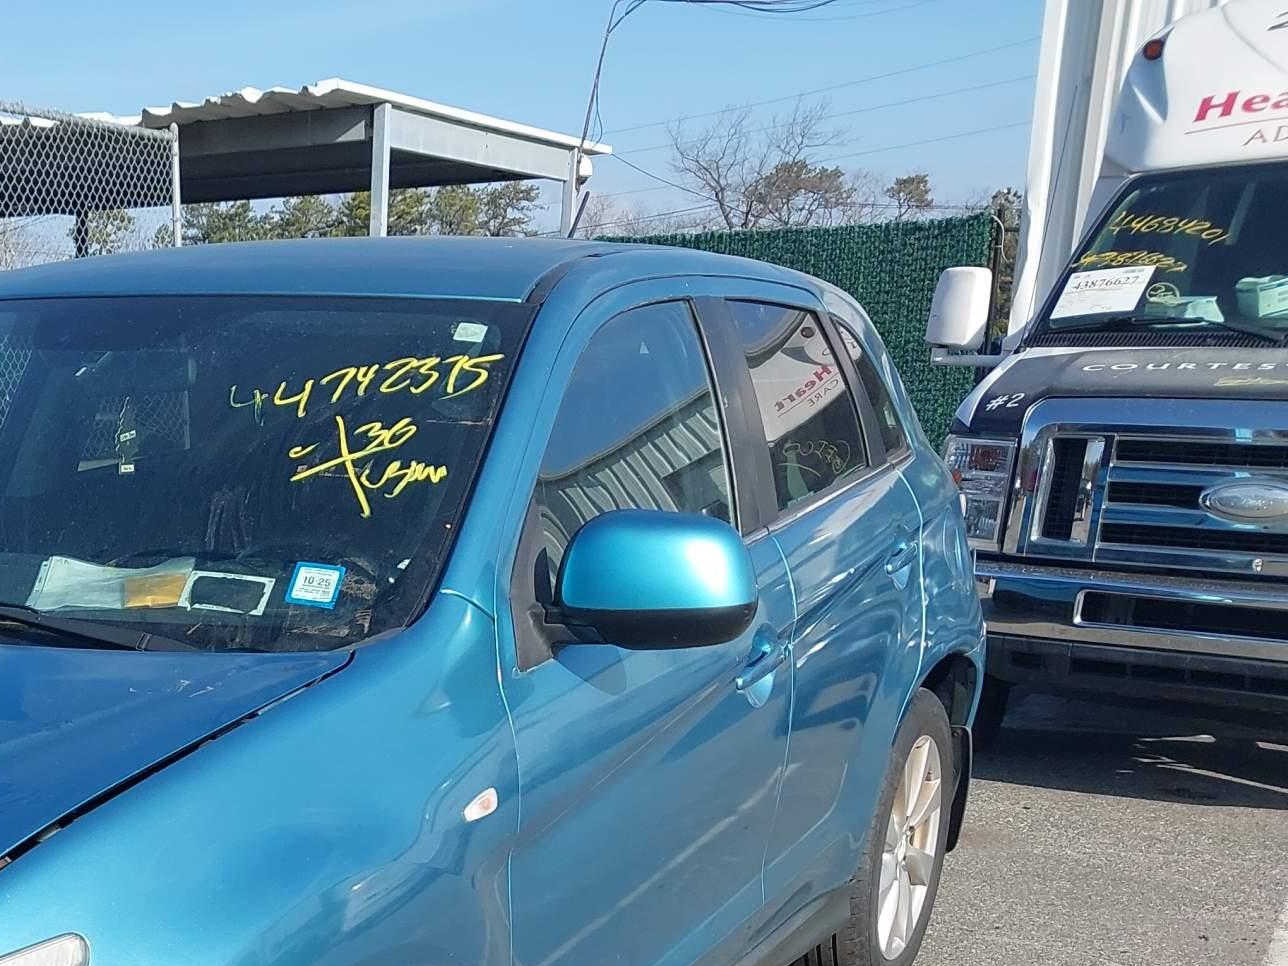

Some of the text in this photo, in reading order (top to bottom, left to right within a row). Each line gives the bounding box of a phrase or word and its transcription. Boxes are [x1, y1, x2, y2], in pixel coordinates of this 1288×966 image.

[1072, 276, 1140, 290] 43876627
[1082, 362, 1288, 372] COURTES
[229, 353, 505, 426] 44742375
[985, 393, 1025, 411] #2
